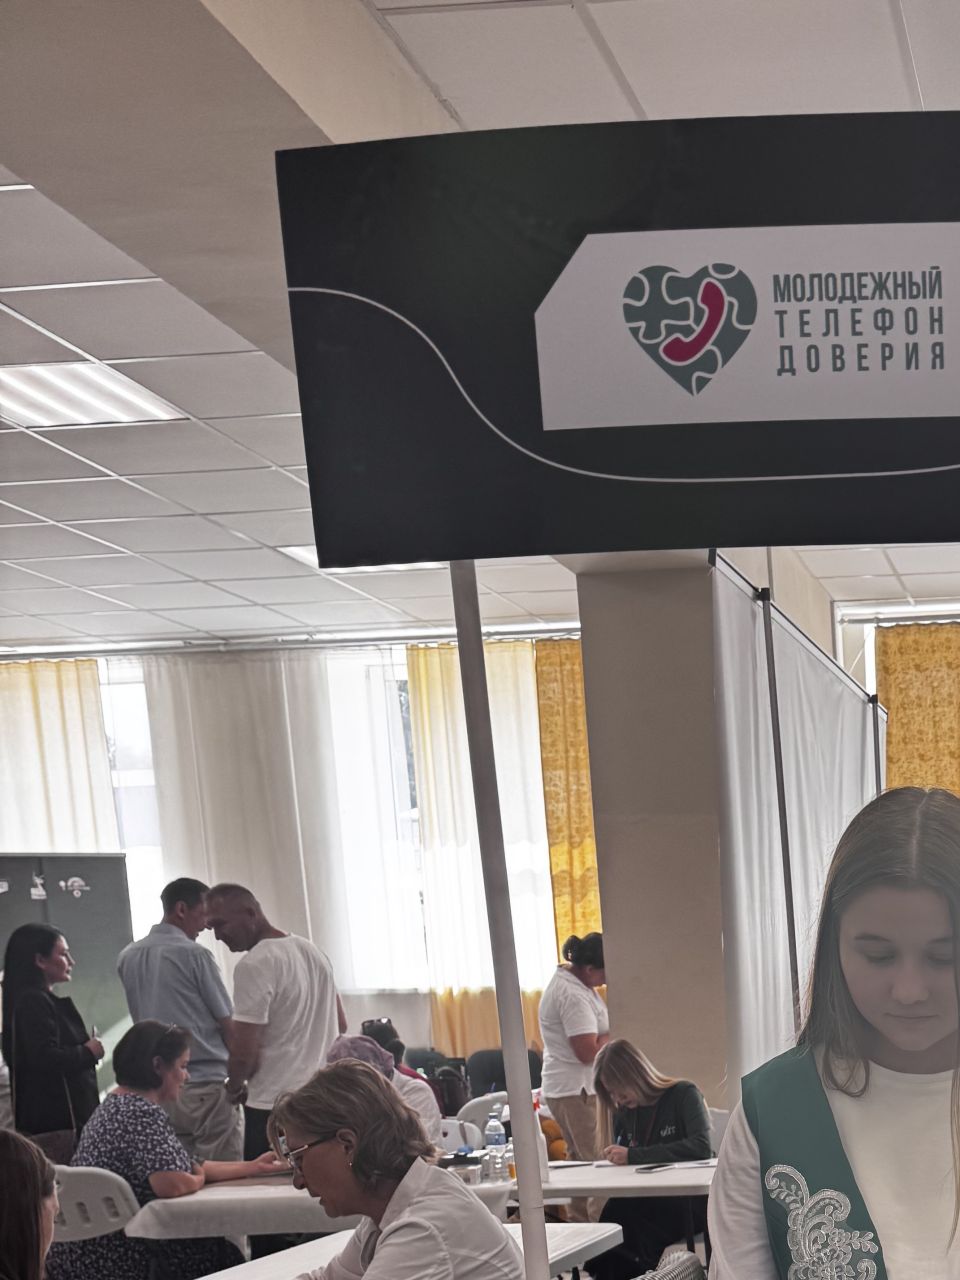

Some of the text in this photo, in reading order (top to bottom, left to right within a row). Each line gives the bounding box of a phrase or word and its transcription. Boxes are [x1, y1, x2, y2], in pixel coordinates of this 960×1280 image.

[772, 265, 943, 305] МОЛОДЕЖНЫЙ
[774, 306, 944, 338] ТЕЛЕФОН
[776, 341, 945, 377] ДОВЕРИЯ
